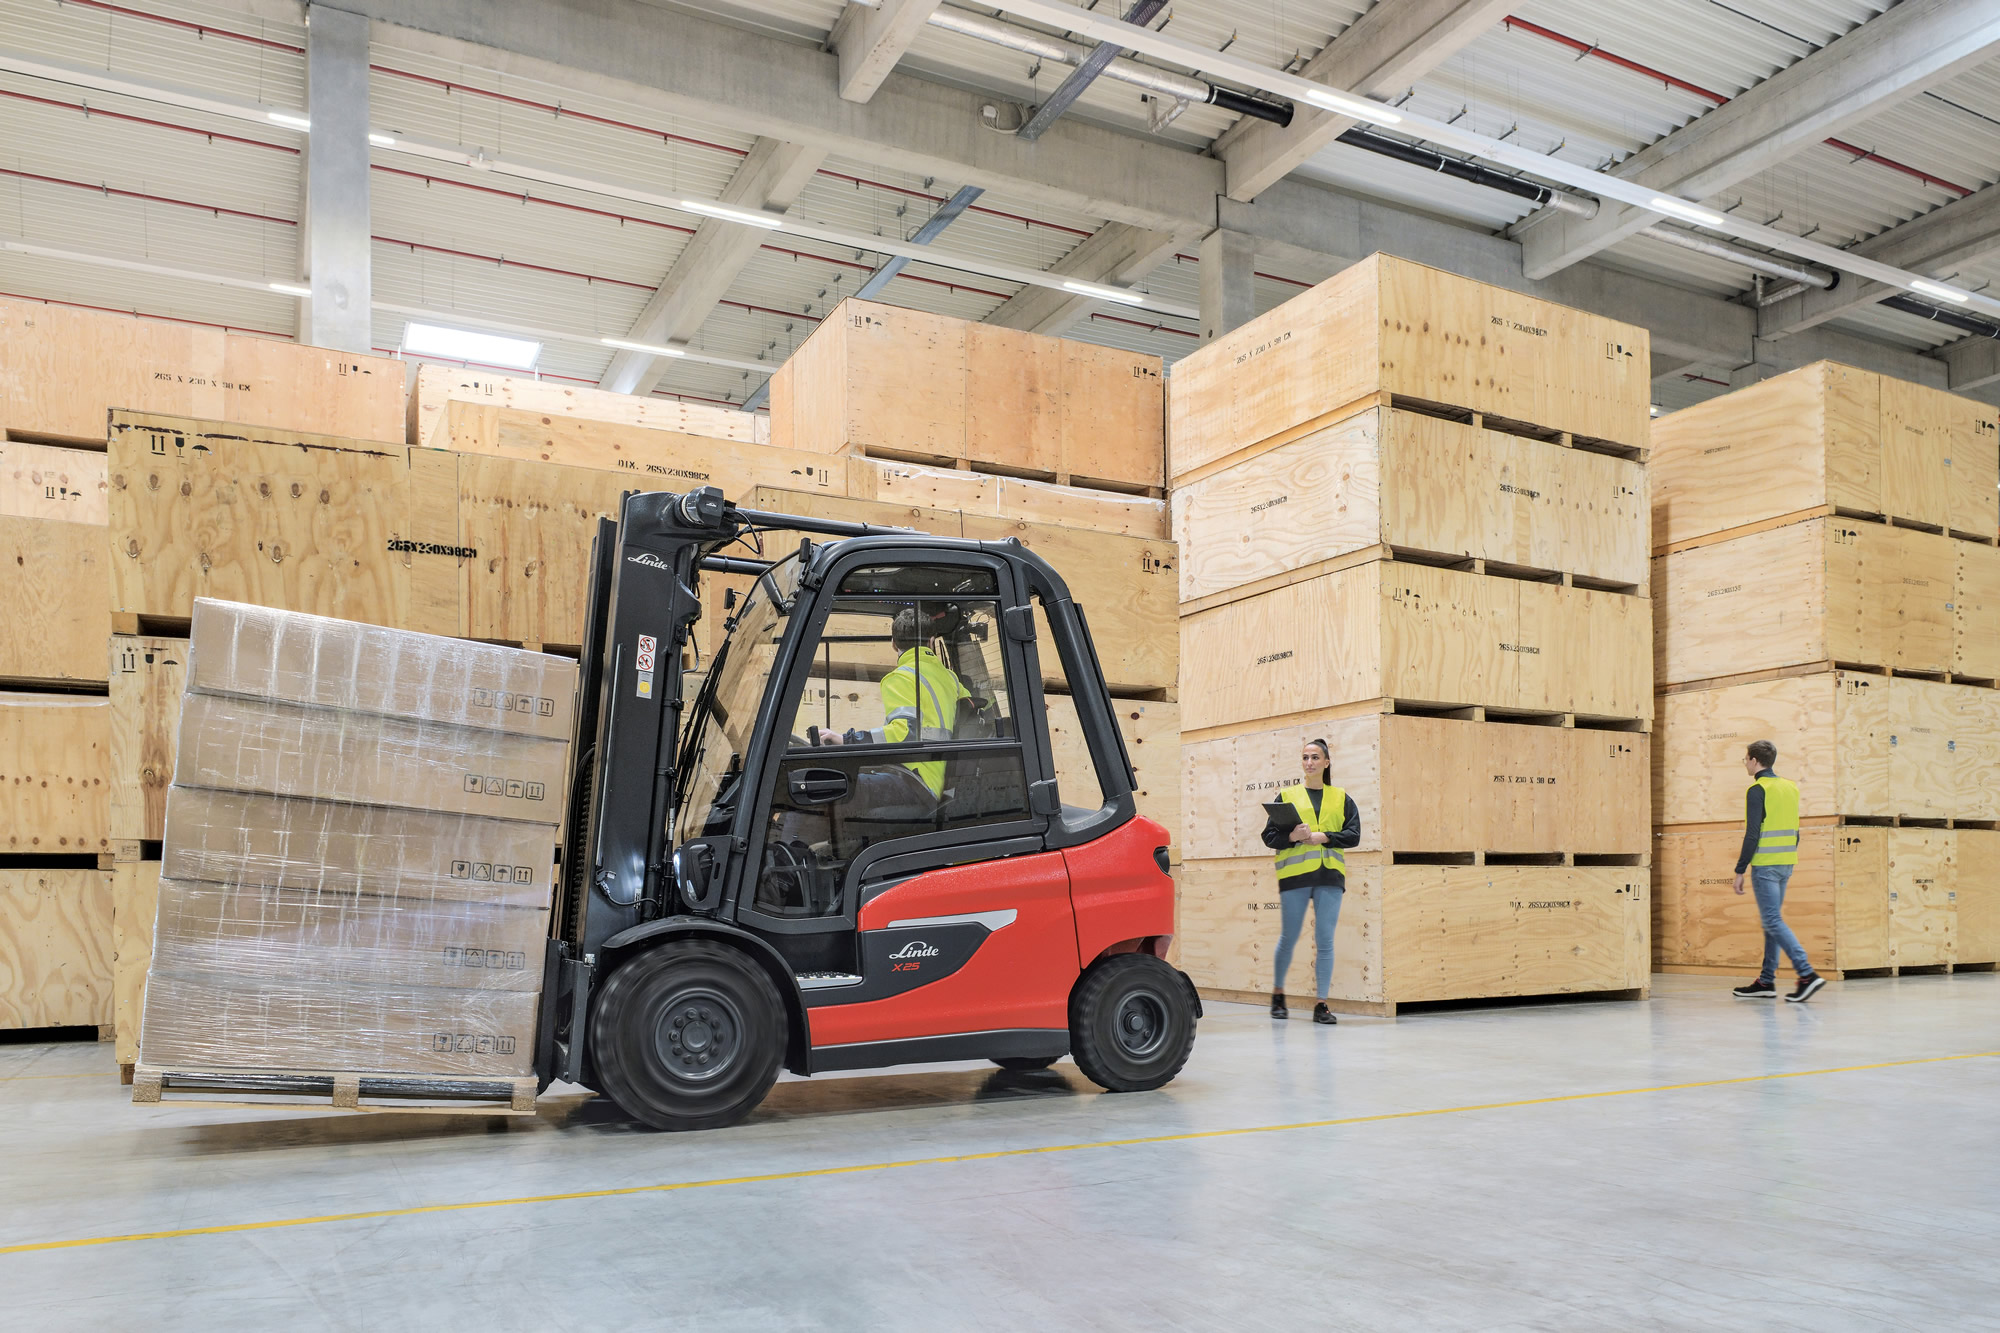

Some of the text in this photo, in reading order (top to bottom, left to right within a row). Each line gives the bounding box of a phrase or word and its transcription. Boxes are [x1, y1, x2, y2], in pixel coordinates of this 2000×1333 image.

[154, 372, 172, 381] 265
[177, 375, 183, 383] X
[189, 377, 206, 385] 230
[645, 464, 710, 481] 265X230X98CM
[387, 539, 478, 559] 265X230X98CM
[627, 553, 668, 570] Linde
[888, 940, 939, 960] Linde
